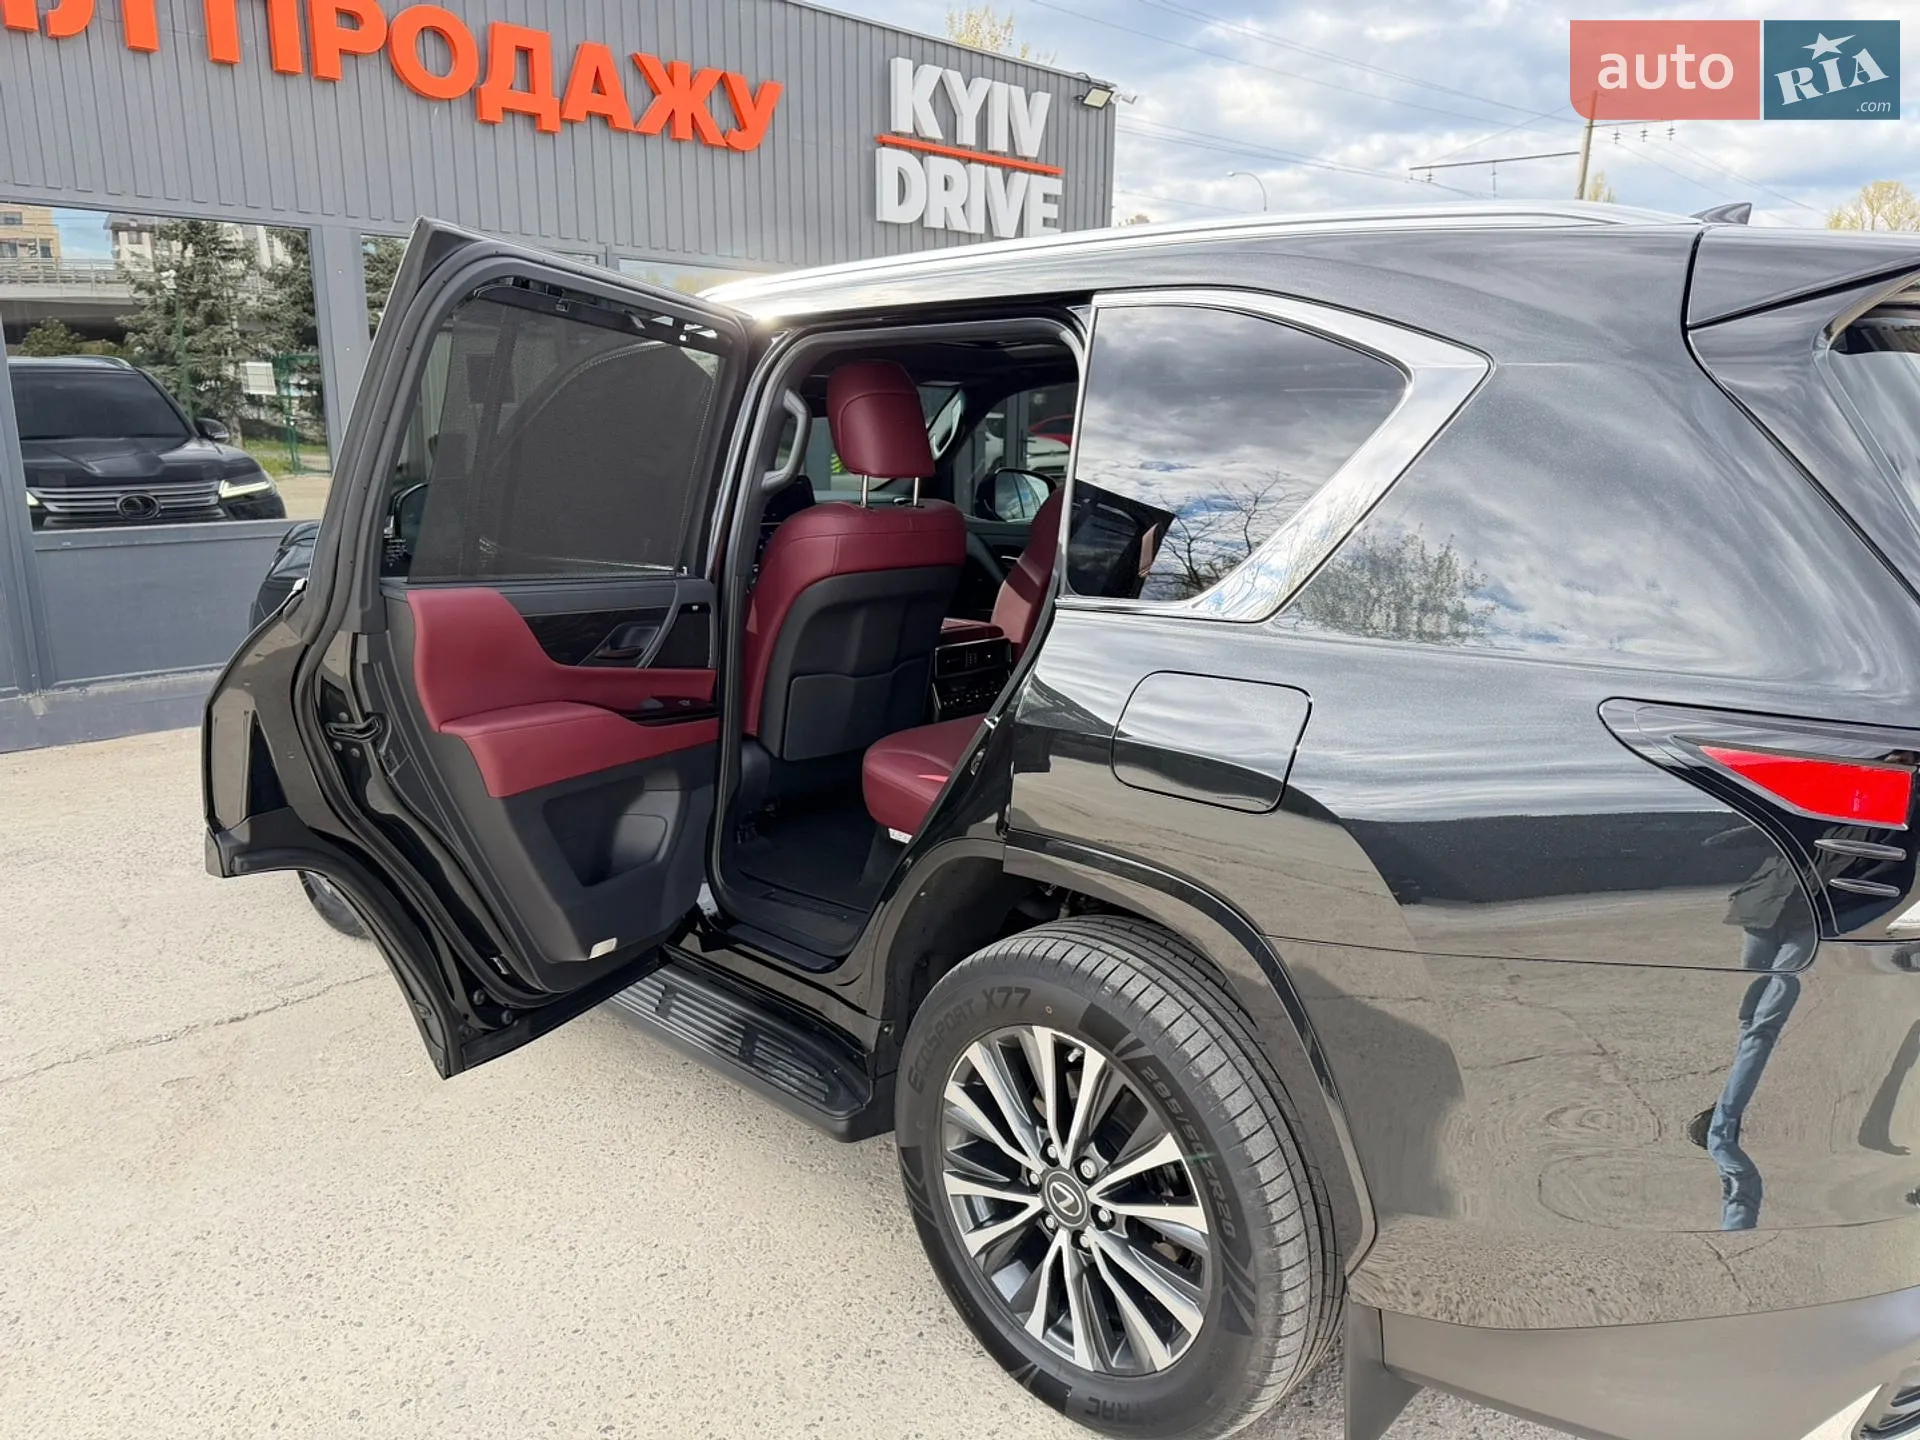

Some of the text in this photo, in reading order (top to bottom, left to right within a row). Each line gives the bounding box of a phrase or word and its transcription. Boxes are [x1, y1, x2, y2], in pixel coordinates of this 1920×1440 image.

[890, 56, 1052, 158] KYIV
[875, 146, 1063, 239] DRIVE
[981, 985, 1032, 1016] X77
